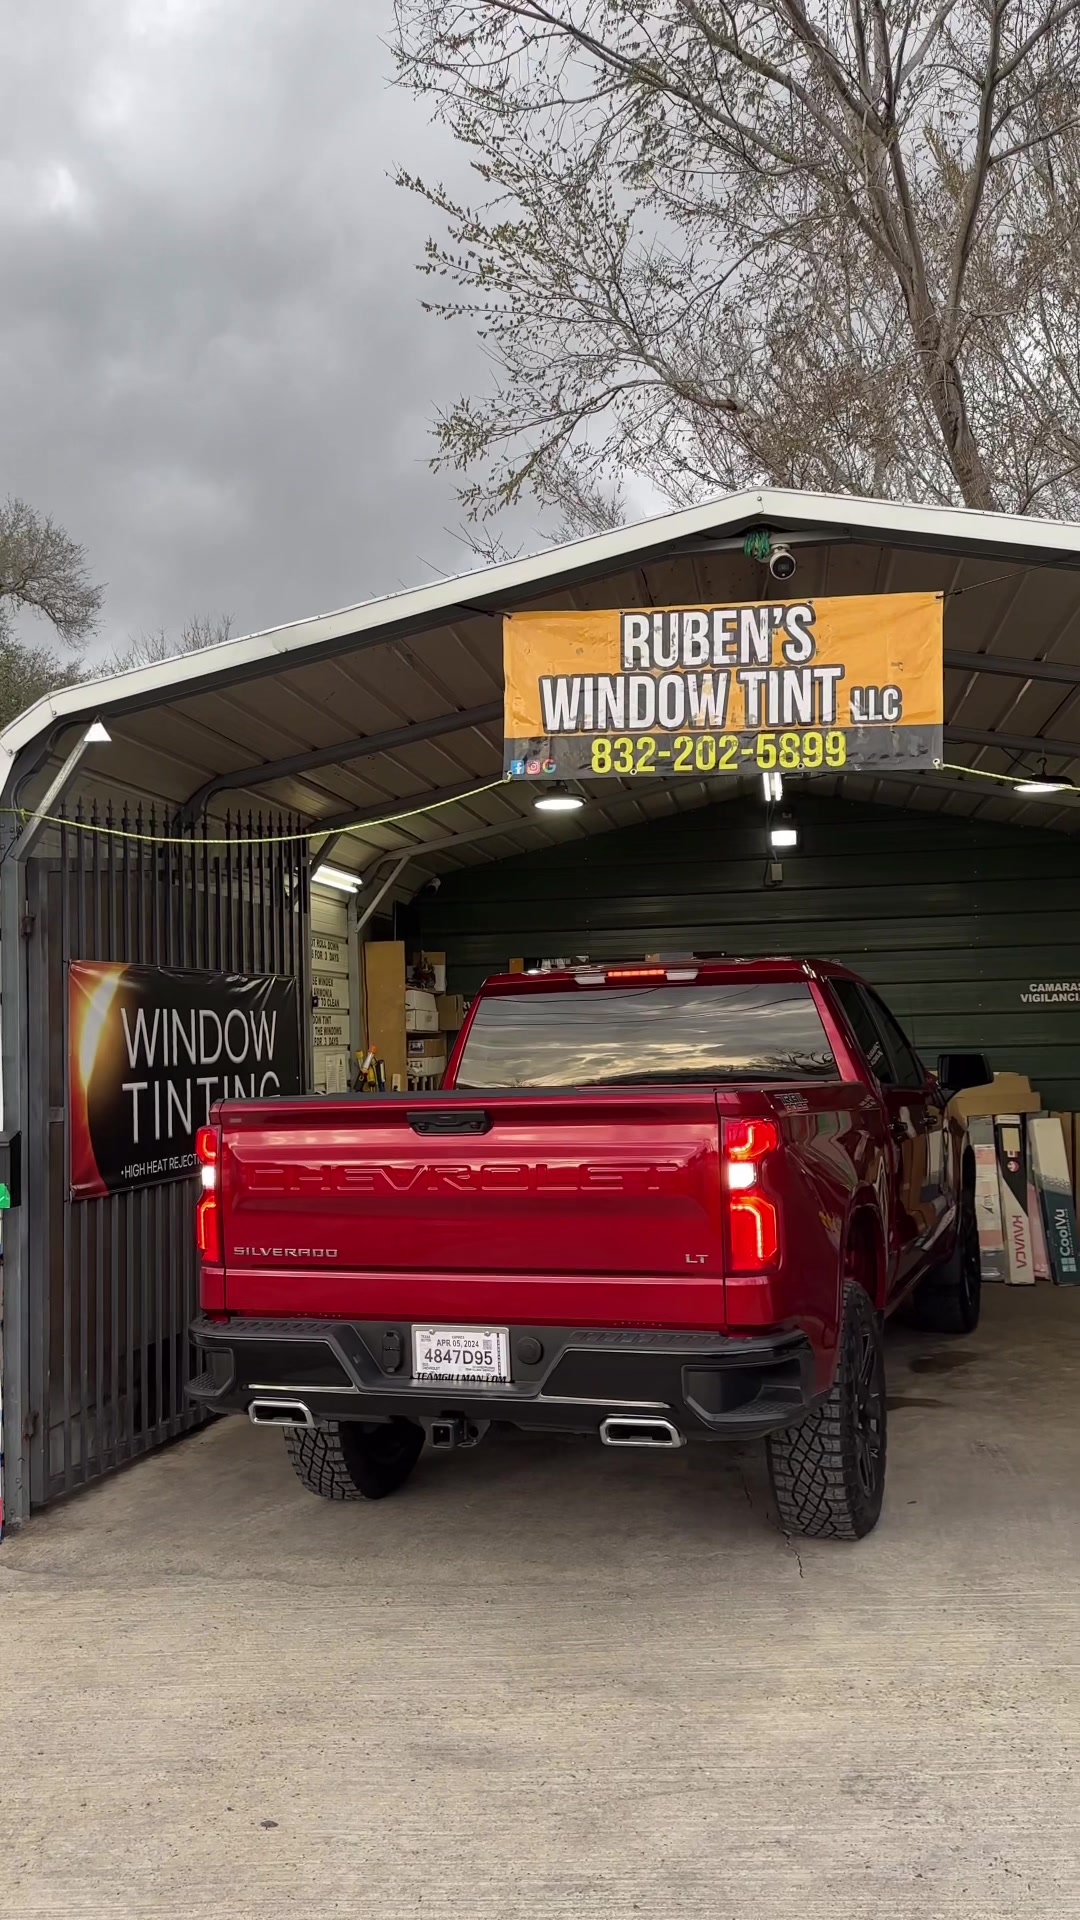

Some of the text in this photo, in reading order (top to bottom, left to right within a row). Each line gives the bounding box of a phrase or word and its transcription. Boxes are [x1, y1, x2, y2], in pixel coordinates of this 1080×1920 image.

[622, 605, 815, 669] RUBEN'S
[541, 667, 901, 732] WINDOW TINT LLC
[591, 731, 848, 774] 832-202-5899
[327, 998, 340, 1007] CLEAN
[1020, 993, 1080, 1002] VIGILANCI
[120, 1007, 277, 1069] WINDOW
[146, 1158, 168, 1175] HEAT
[248, 1163, 680, 1191] CHEVROLET
[1012, 1215, 1027, 1269] KAVACA
[1054, 1208, 1071, 1257] CoolVu
[233, 1246, 338, 1258] SILVERADO
[685, 1253, 709, 1264] LT
[436, 1339, 451, 1347] APR
[463, 1340, 479, 1348] 2024
[424, 1348, 493, 1366] 4847D95
